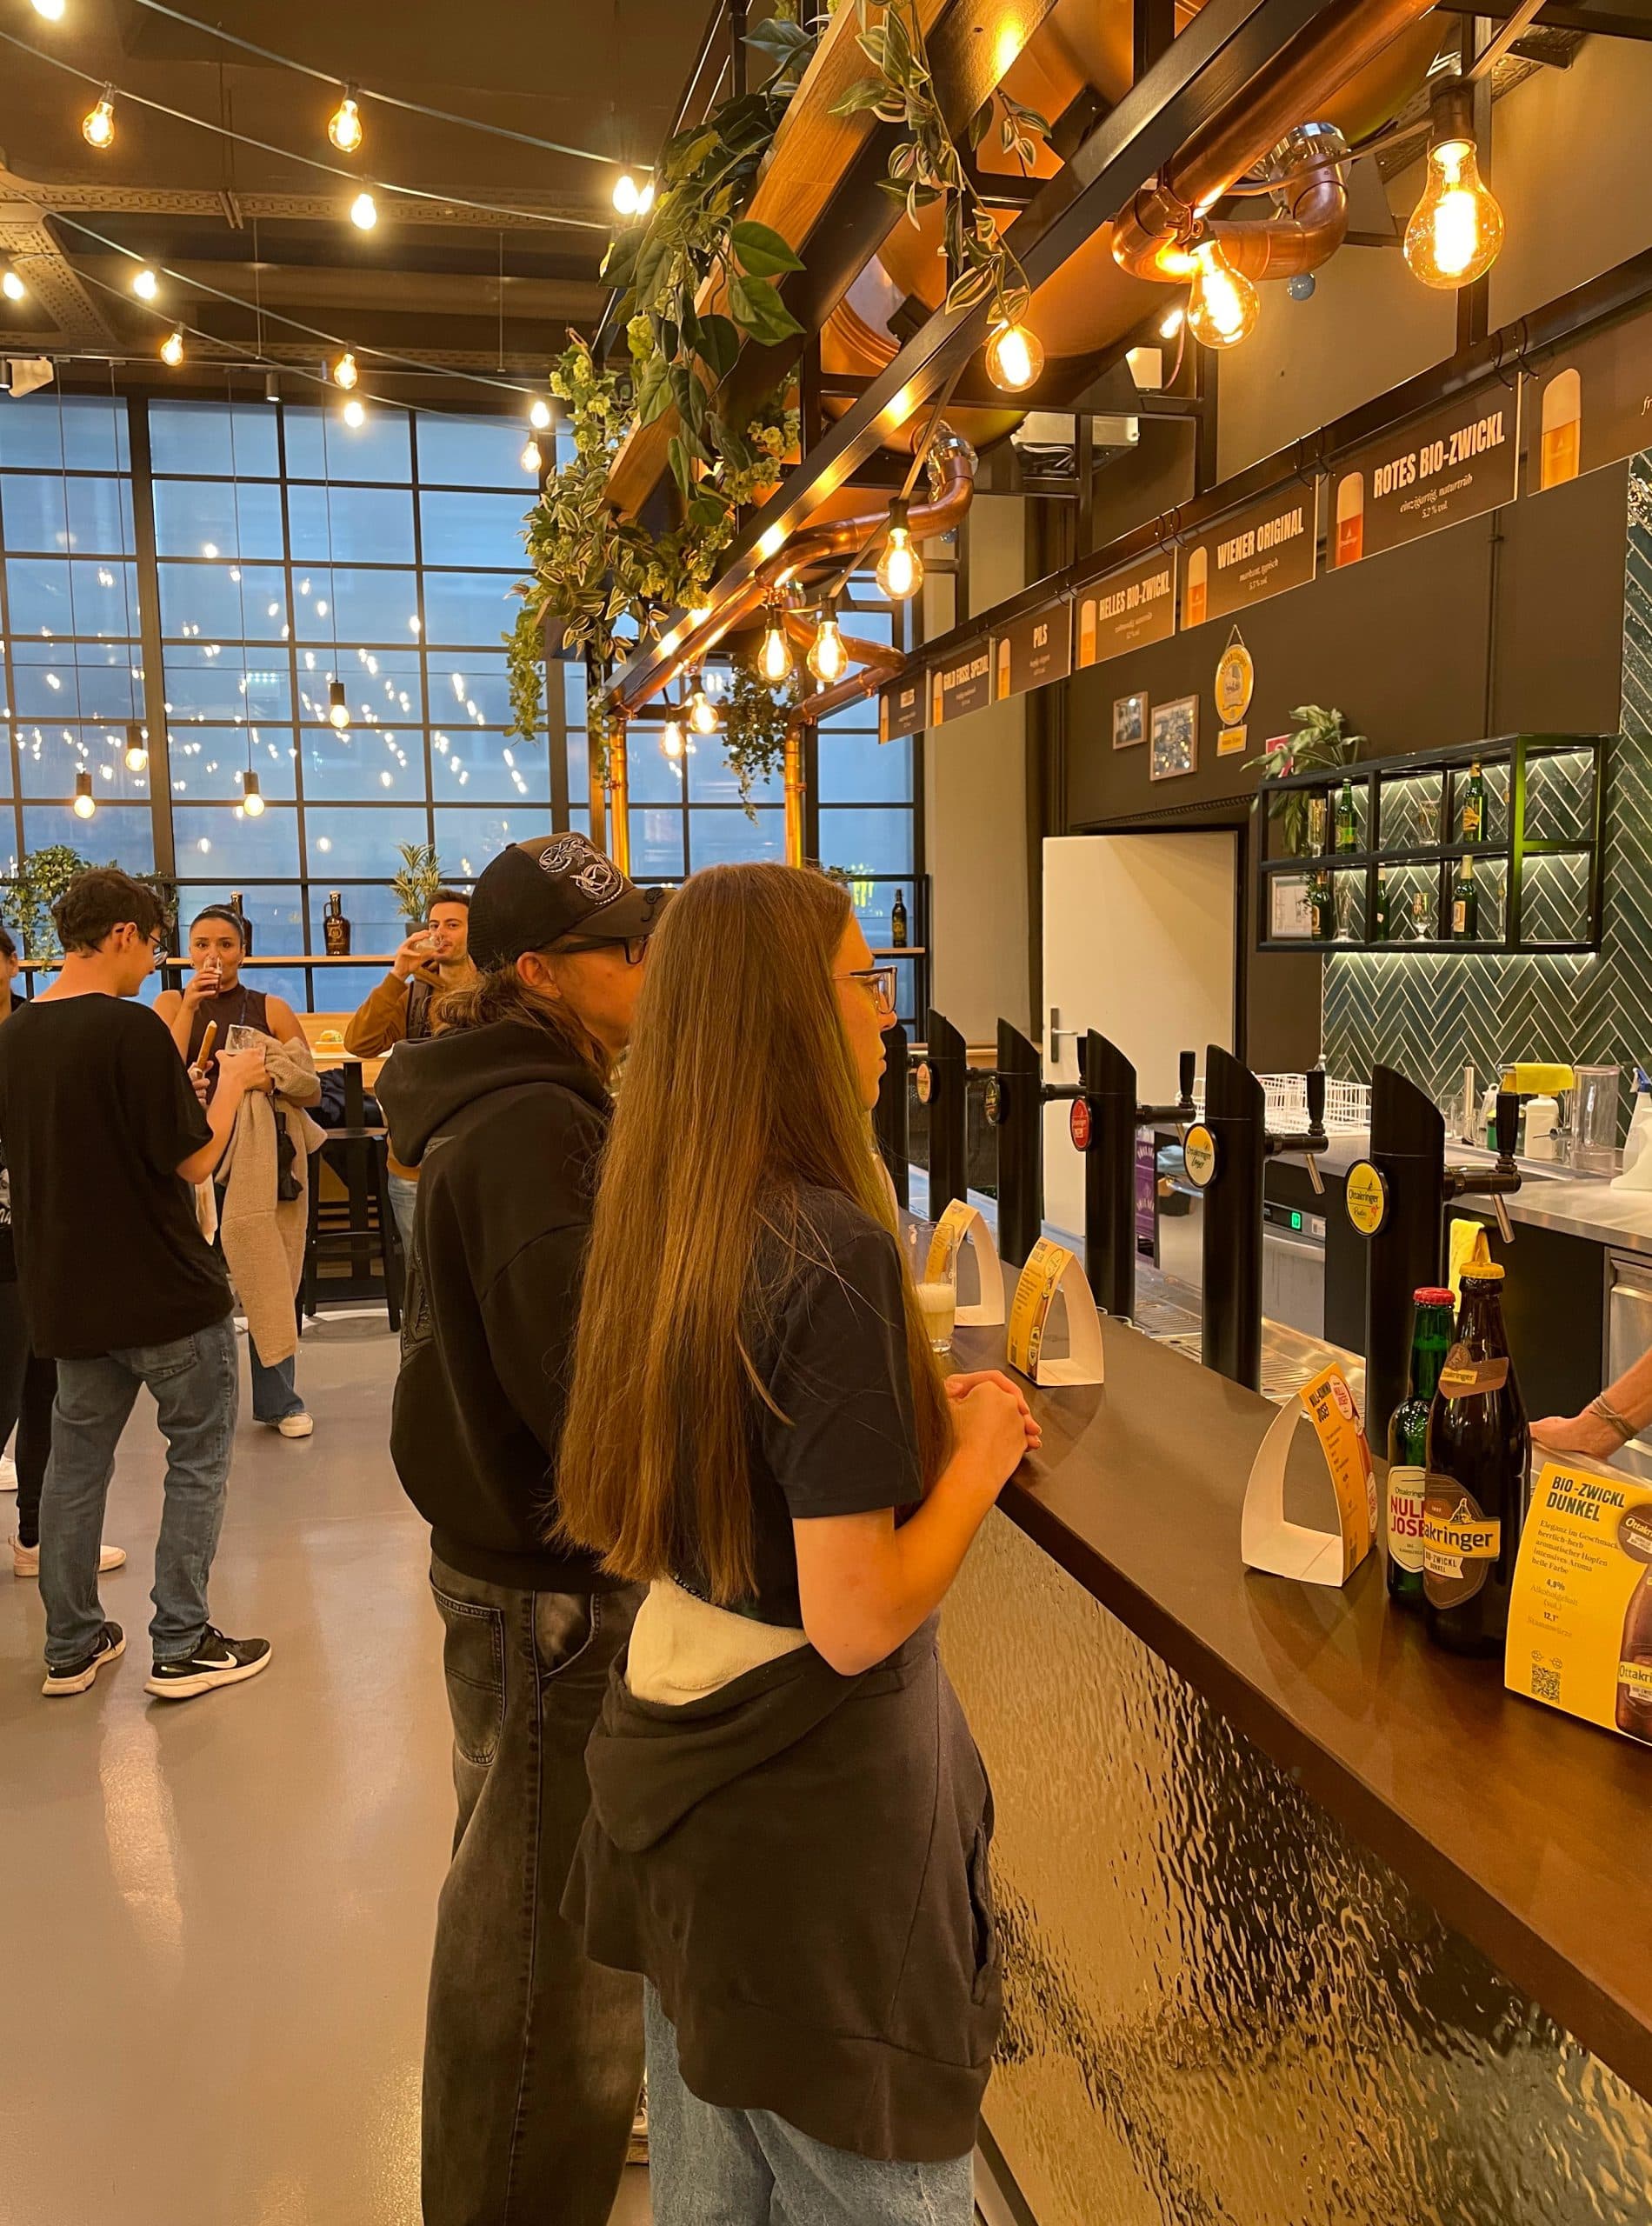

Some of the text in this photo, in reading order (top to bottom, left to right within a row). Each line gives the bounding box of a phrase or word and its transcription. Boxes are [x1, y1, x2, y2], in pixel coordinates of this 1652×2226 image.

[1374, 411, 1505, 499] ROTES BIO-ZWICKL
[1217, 507, 1304, 570] WIENER ORIGINAL
[1099, 570, 1170, 621] HELLES BIO-ZWICKL
[1033, 623, 1048, 649] PILS
[1349, 1190, 1379, 1205] Ottakringer
[1546, 1491, 1601, 1522] DUNKEL
[1540, 1519, 1568, 1534] Eleganz
[1569, 1529, 1578, 1538] im
[1535, 1540, 1608, 1567] aromatischer Hopfen
[1569, 1559, 1593, 1572] Aroma
[1548, 1563, 1569, 1574] Farbe
